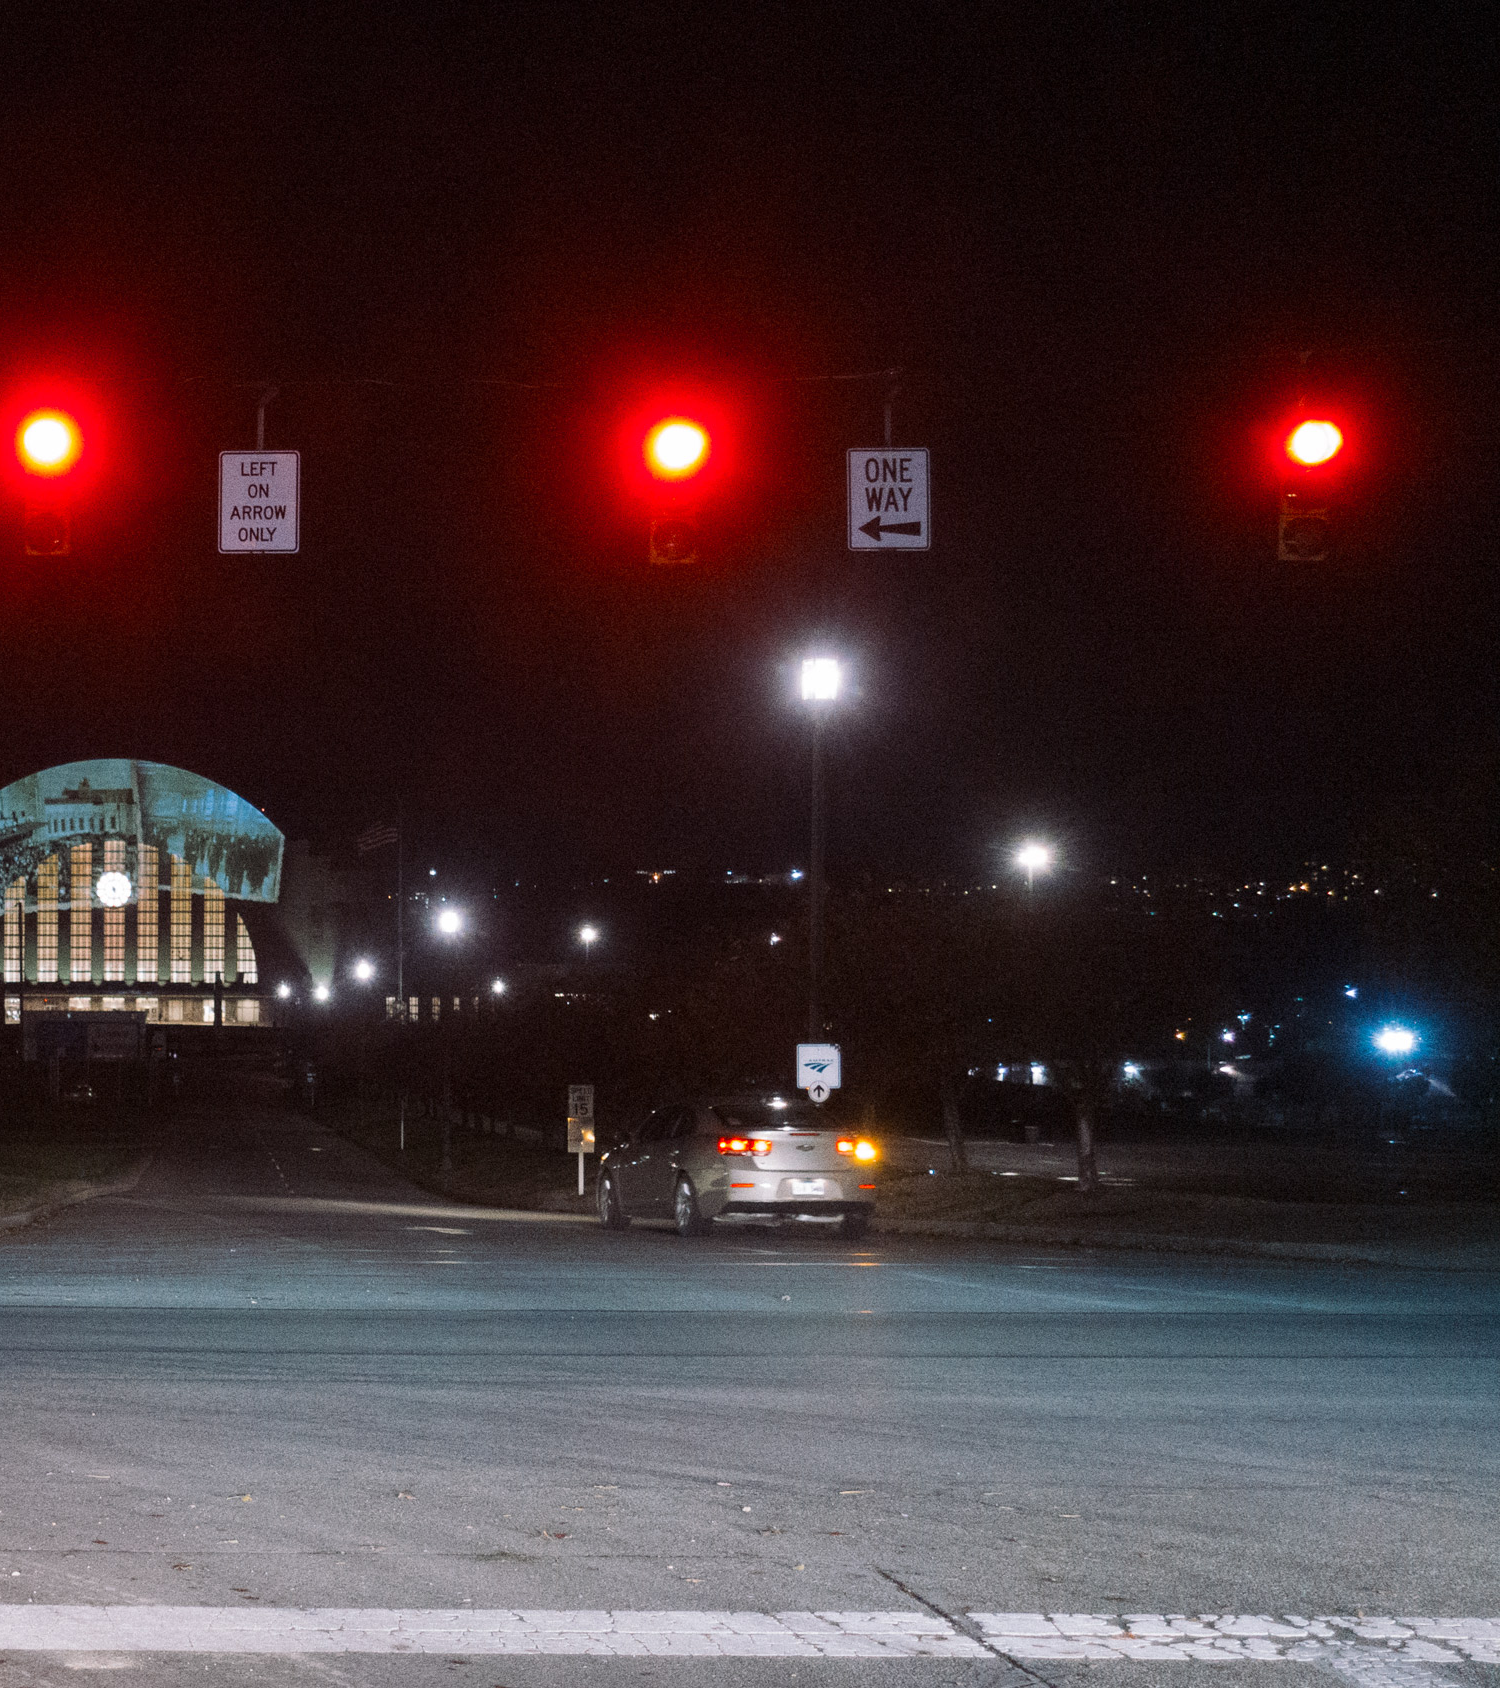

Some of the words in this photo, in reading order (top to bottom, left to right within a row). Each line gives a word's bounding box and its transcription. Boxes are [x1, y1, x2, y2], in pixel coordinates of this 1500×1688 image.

[241, 461, 278, 477] LEFT
[865, 457, 912, 483] ONE
[248, 483, 269, 499] ON
[865, 487, 913, 512] WAY
[230, 505, 286, 521] ARROW
[238, 527, 277, 542] ONLY
[570, 1087, 592, 1095] SPEED
[574, 1103, 588, 1116] 15
